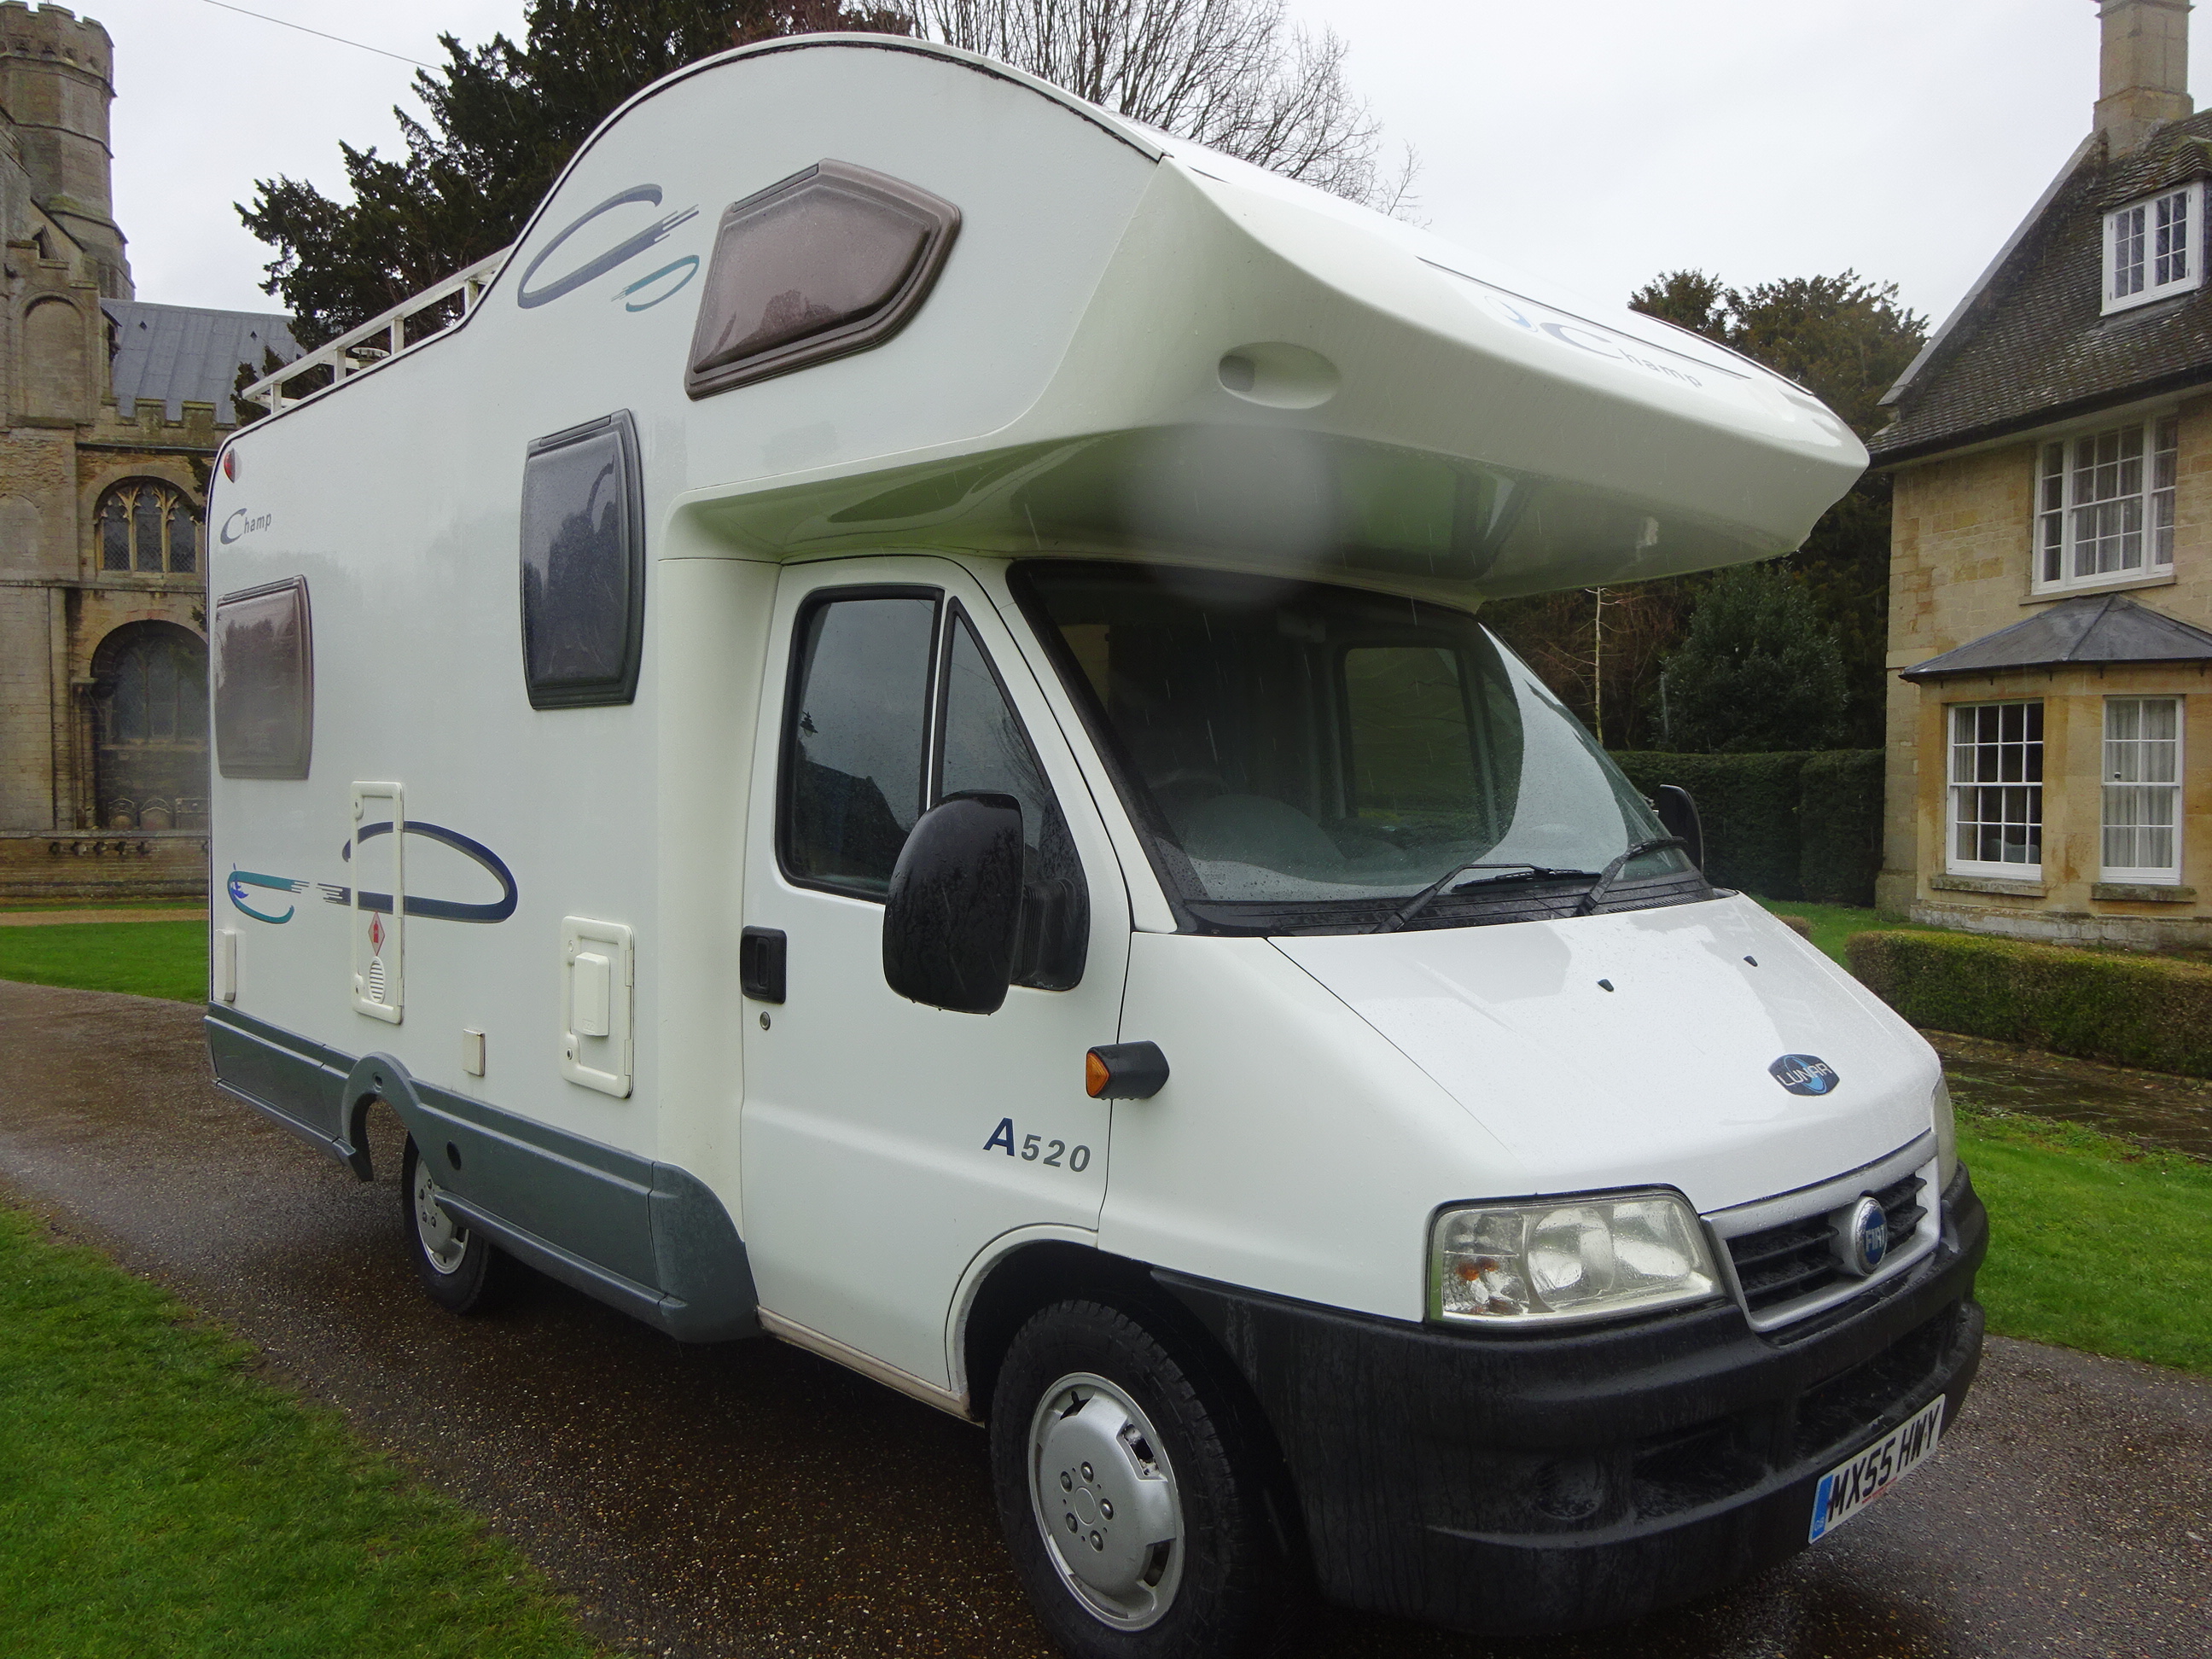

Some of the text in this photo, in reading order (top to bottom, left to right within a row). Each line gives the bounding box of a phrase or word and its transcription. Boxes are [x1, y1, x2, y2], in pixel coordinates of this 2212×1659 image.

[1540, 322, 1703, 388] Champ
[219, 507, 272, 545] Champ
[1776, 1062, 1833, 1086] LUNAR
[982, 1117, 1091, 1173] A520
[1865, 1225, 1885, 1254] FIAT
[1827, 1404, 1941, 1523] MX55 HWY
